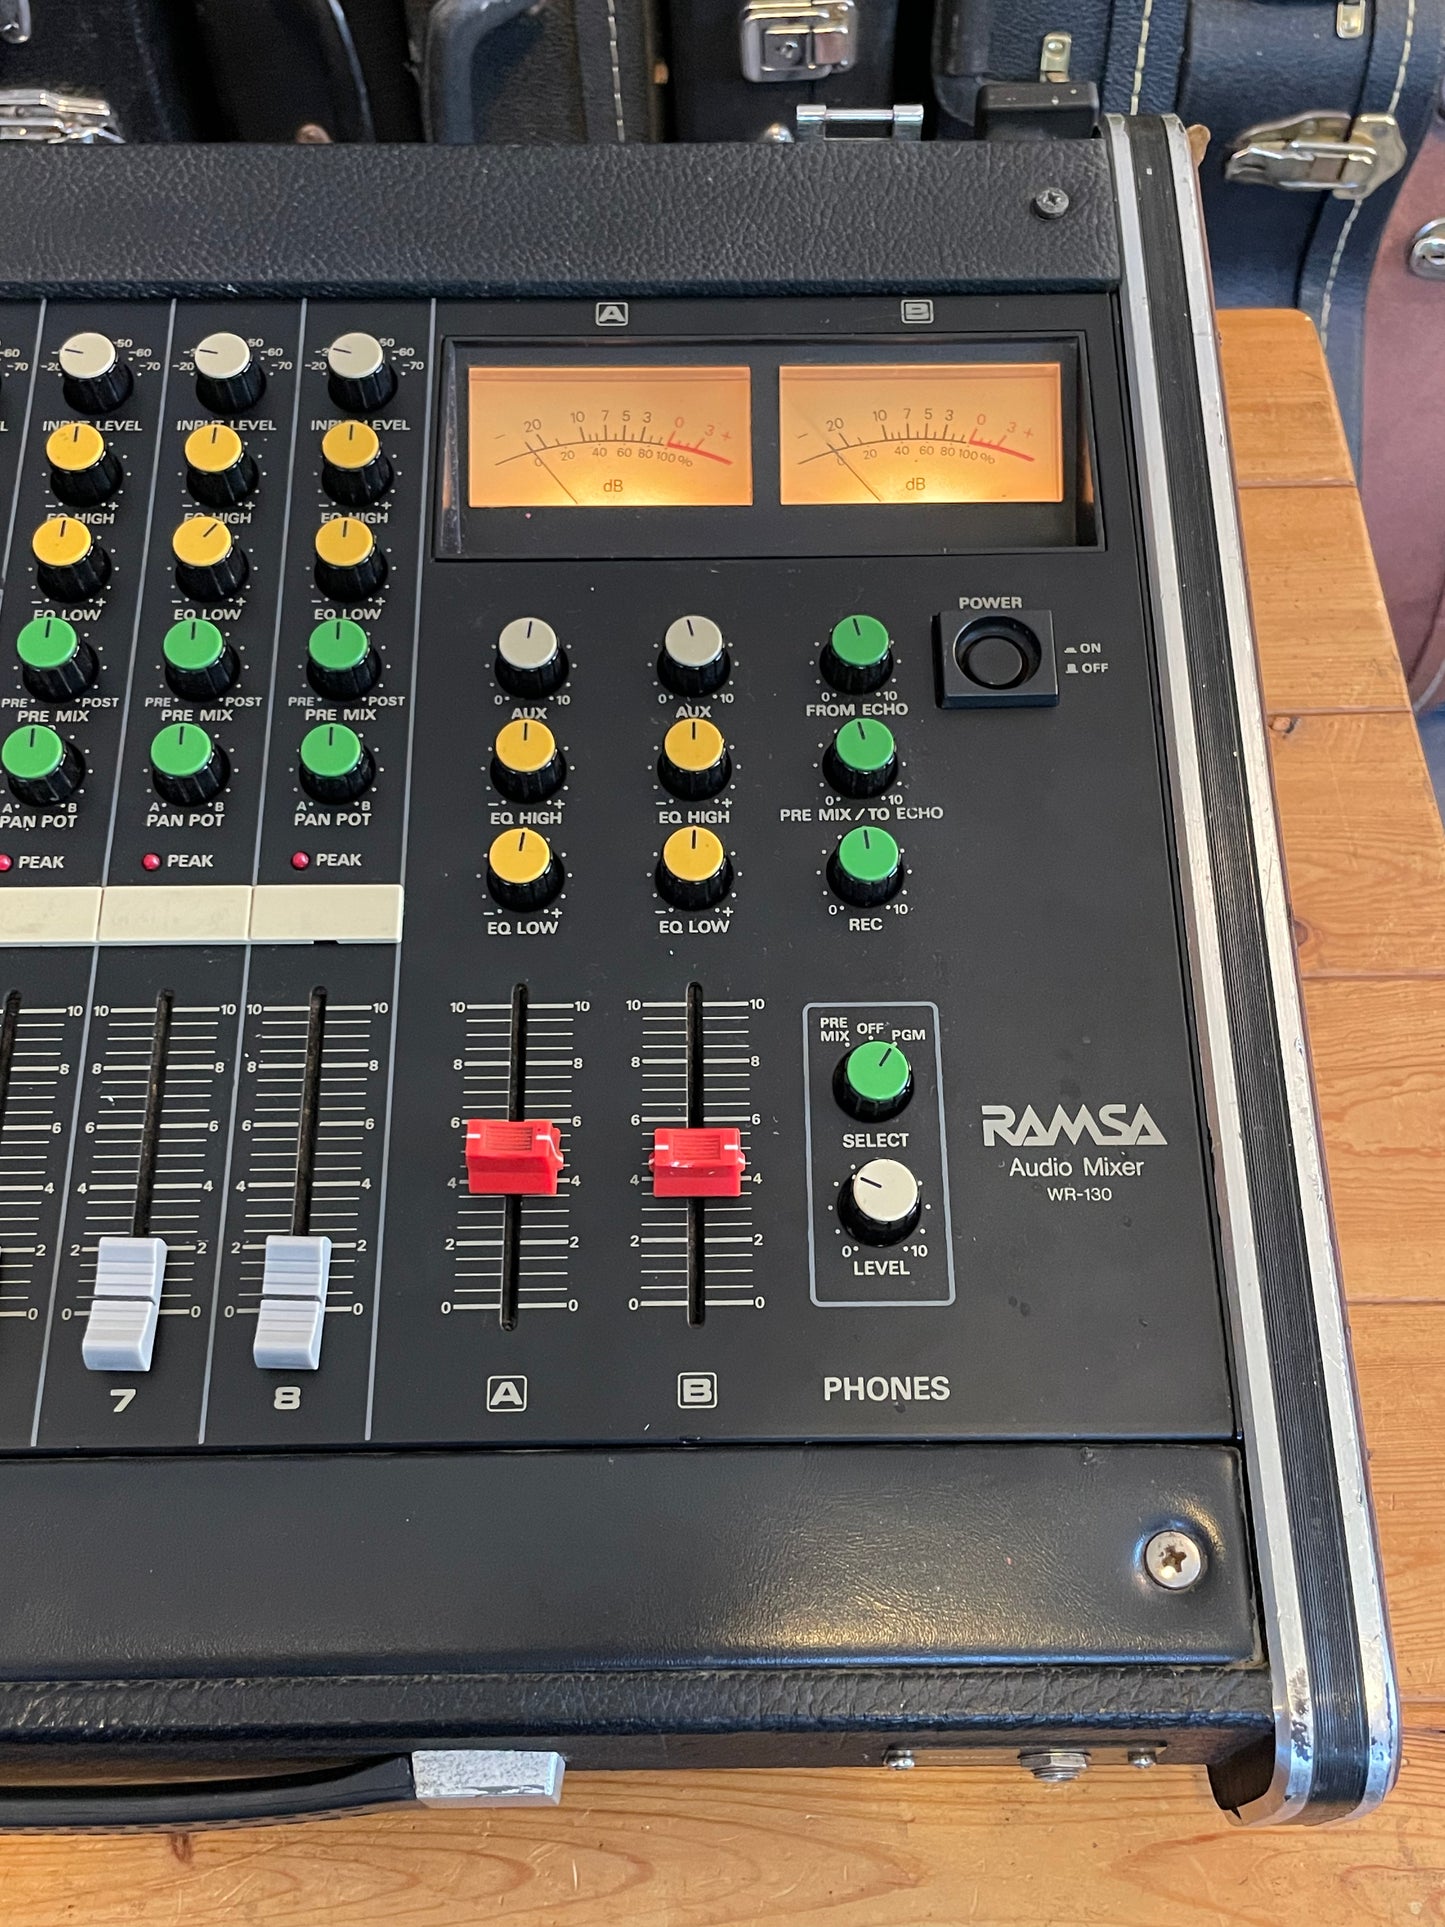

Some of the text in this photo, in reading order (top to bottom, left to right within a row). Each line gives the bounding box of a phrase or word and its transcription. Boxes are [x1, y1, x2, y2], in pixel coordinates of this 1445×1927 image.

[599, 306, 624, 321] A
[905, 305, 929, 319] B
[95, 421, 143, 431] LEVEL
[230, 420, 276, 431] LEVEL
[524, 410, 652, 433] 20 10 7 5 3
[826, 409, 954, 432] 20 10 7 5 3
[561, 447, 653, 461] 20 40 60 80
[863, 446, 955, 460] 20 40 60 80
[603, 479, 623, 492] dB
[906, 478, 926, 491] dB
[349, 513, 388, 524] HIGH
[959, 597, 1022, 609] POWER
[61, 609, 101, 621] LOW
[201, 609, 241, 620] LOW
[342, 608, 381, 620] LOW
[1080, 643, 1101, 653] ON
[1082, 663, 1108, 673] OFF
[225, 697, 262, 707] POST
[288, 697, 315, 707] PRE
[368, 697, 405, 707] POST
[494, 695, 503, 705] 0
[556, 695, 571, 705] 10
[658, 694, 667, 704] 0
[720, 694, 734, 703] 10
[821, 692, 830, 702] 0
[884, 691, 897, 701] 10
[1, 699, 28, 708] PRE
[82, 698, 119, 708] POST
[145, 698, 171, 707] PRE
[161, 709, 233, 721] PRE MIX
[305, 709, 377, 721] PRE MIX
[511, 708, 547, 719] AUX
[676, 706, 711, 718] AUX
[806, 703, 908, 716] FROM ECHO
[18, 710, 89, 723] PRE MIX
[825, 796, 834, 806] 0
[888, 795, 903, 805] 10
[147, 814, 225, 827] PAN POT
[294, 813, 372, 826] PAN POT
[490, 812, 562, 825] EQ HIGH
[659, 811, 730, 823] EQ HIGH
[780, 809, 812, 822] PRE
[896, 807, 944, 820] ECHO
[0, 815, 77, 828] PAN POT
[18, 856, 64, 869] PEAK
[167, 855, 213, 867] PEAK
[316, 854, 362, 866] PEAK
[828, 905, 837, 915] 0
[893, 904, 908, 915] 10
[488, 921, 559, 935] EQ LOW
[659, 920, 730, 933] EQ LOW
[849, 918, 883, 931] REC
[220, 1003, 236, 1016] 10
[247, 1003, 262, 1015] 10
[373, 1002, 388, 1014] 10
[450, 1001, 466, 1014] 10
[574, 1000, 590, 1012] 10
[626, 999, 641, 1011] 10
[749, 998, 765, 1011] 10
[93, 1005, 109, 1017] 10
[820, 1018, 848, 1029] PRE
[857, 1023, 884, 1034] OFF
[820, 1031, 849, 1042] MIX
[891, 1030, 926, 1041] PGM
[215, 1061, 225, 1073] 8
[247, 1061, 257, 1073] 8
[368, 1060, 379, 1072] 8
[453, 1059, 463, 1070] 8
[573, 1058, 583, 1070] 8
[630, 1056, 641, 1068] 8
[750, 1056, 760, 1067] 8
[92, 1063, 102, 1075] 8
[241, 1119, 252, 1131] 6
[364, 1118, 375, 1130] 6
[450, 1117, 460, 1129] 6
[572, 1115, 582, 1128] 6
[630, 1114, 641, 1126] 6
[751, 1114, 761, 1125] 6
[981, 1103, 1168, 1146] RAMSA
[85, 1122, 95, 1134] 6
[208, 1121, 218, 1132] 6
[842, 1133, 909, 1149] SELECT
[1009, 1157, 1145, 1177] Audio Mixer
[360, 1178, 371, 1189] 4
[447, 1176, 457, 1188] 4
[570, 1176, 581, 1188] 4
[629, 1175, 640, 1186] 4
[752, 1173, 763, 1185] 4
[77, 1183, 87, 1194] 4
[202, 1180, 213, 1192] 4
[236, 1180, 246, 1192] 4
[1047, 1187, 1113, 1202] WR-130
[356, 1240, 367, 1251] 2
[444, 1238, 455, 1250] 2
[569, 1236, 580, 1248] 2
[629, 1236, 640, 1247] 2
[753, 1234, 763, 1246] 2
[70, 1244, 80, 1256] 2
[197, 1242, 207, 1254] 2
[231, 1242, 241, 1253] 2
[841, 1245, 852, 1258] 0
[911, 1245, 928, 1257] 10
[854, 1261, 910, 1276] LEVEL
[352, 1303, 363, 1315] 0
[441, 1302, 451, 1314] 0
[568, 1299, 579, 1312] 0
[628, 1298, 639, 1311] 0
[754, 1297, 765, 1309] 0
[61, 1308, 72, 1320] 0
[190, 1306, 201, 1318] 0
[224, 1306, 235, 1318] 0
[490, 1382, 523, 1405] A
[683, 1379, 713, 1402] B
[823, 1376, 951, 1401] PHONES
[111, 1389, 136, 1412] 7
[274, 1386, 301, 1410] 8
